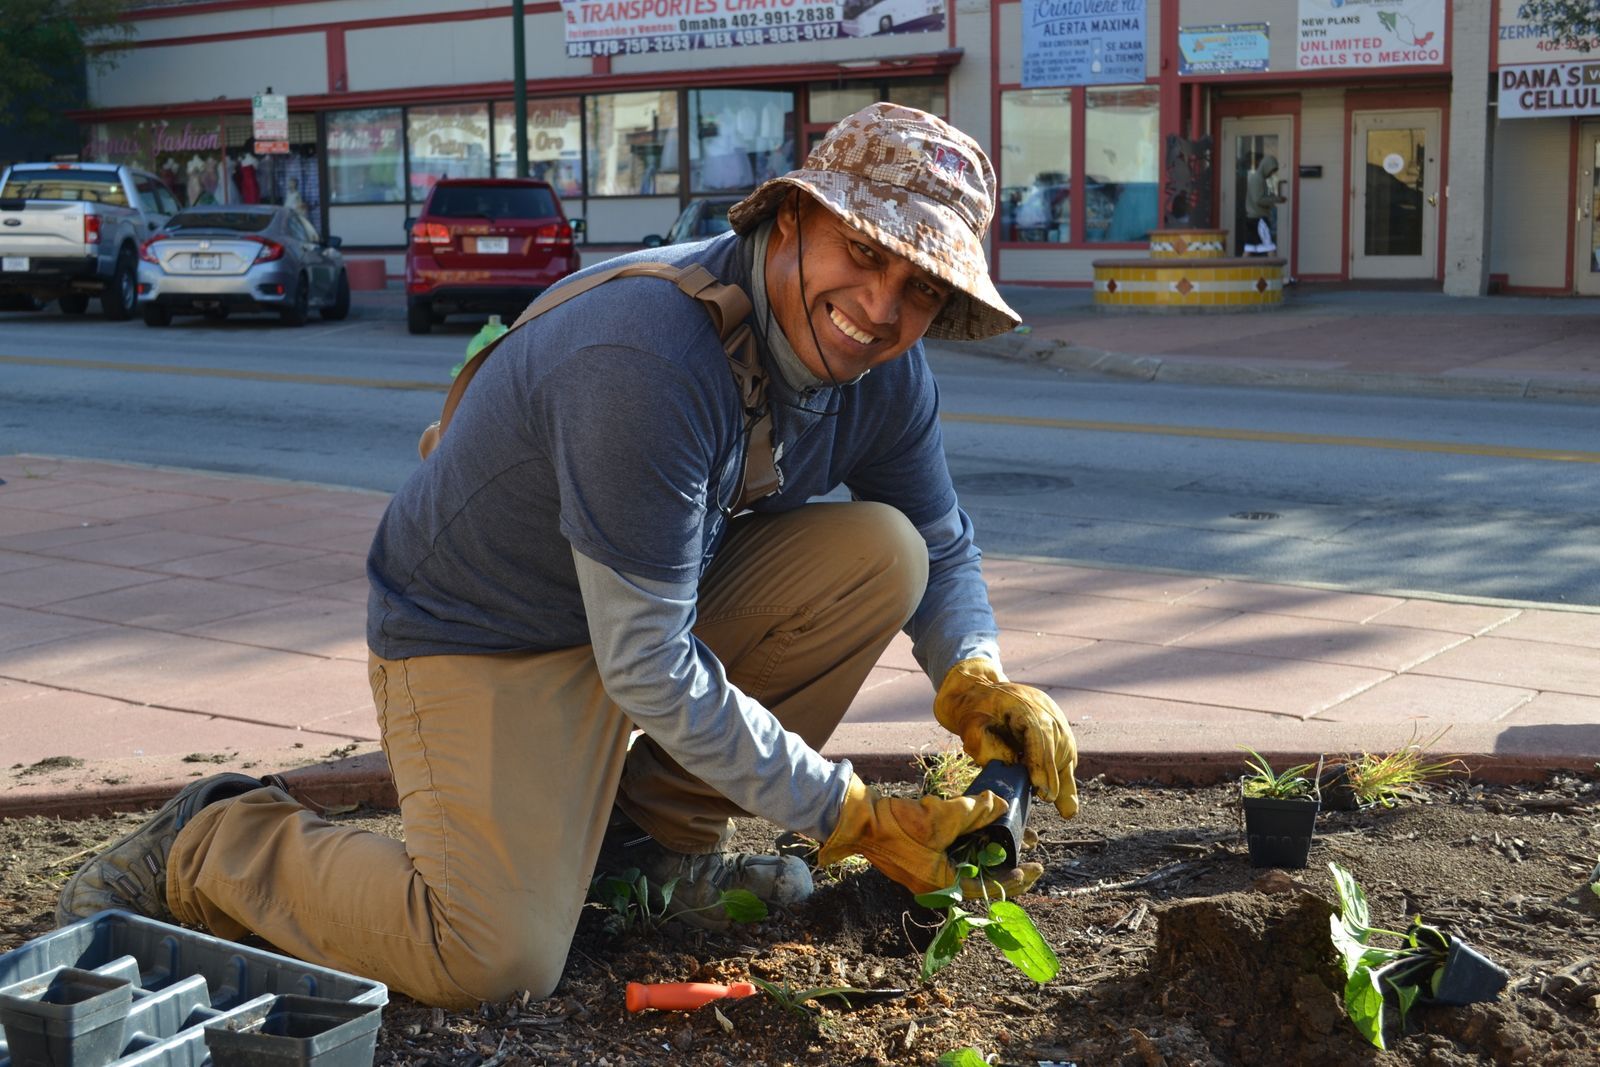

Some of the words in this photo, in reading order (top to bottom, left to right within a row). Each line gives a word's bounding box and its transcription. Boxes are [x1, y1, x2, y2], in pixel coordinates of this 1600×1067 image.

[580, 0, 719, 23] TRANSPORTES
[679, 14, 728, 32] Omaha
[731, 7, 835, 28] 402-991-2838
[1301, 18, 1324, 26] NEW
[1327, 16, 1360, 25] PLANS
[1043, 20, 1088, 36] ALERTA
[1091, 18, 1140, 33] MAXIMA
[1301, 29, 1327, 37] WITH
[1300, 37, 1383, 52] UNLIMITED
[1300, 54, 1347, 66] CALLS
[1352, 52, 1372, 63] TO
[1378, 49, 1439, 63] MEXICO
[1502, 64, 1581, 90] DANA'S
[1519, 88, 1600, 111] CELLUL
[150, 122, 219, 157] Fashion
